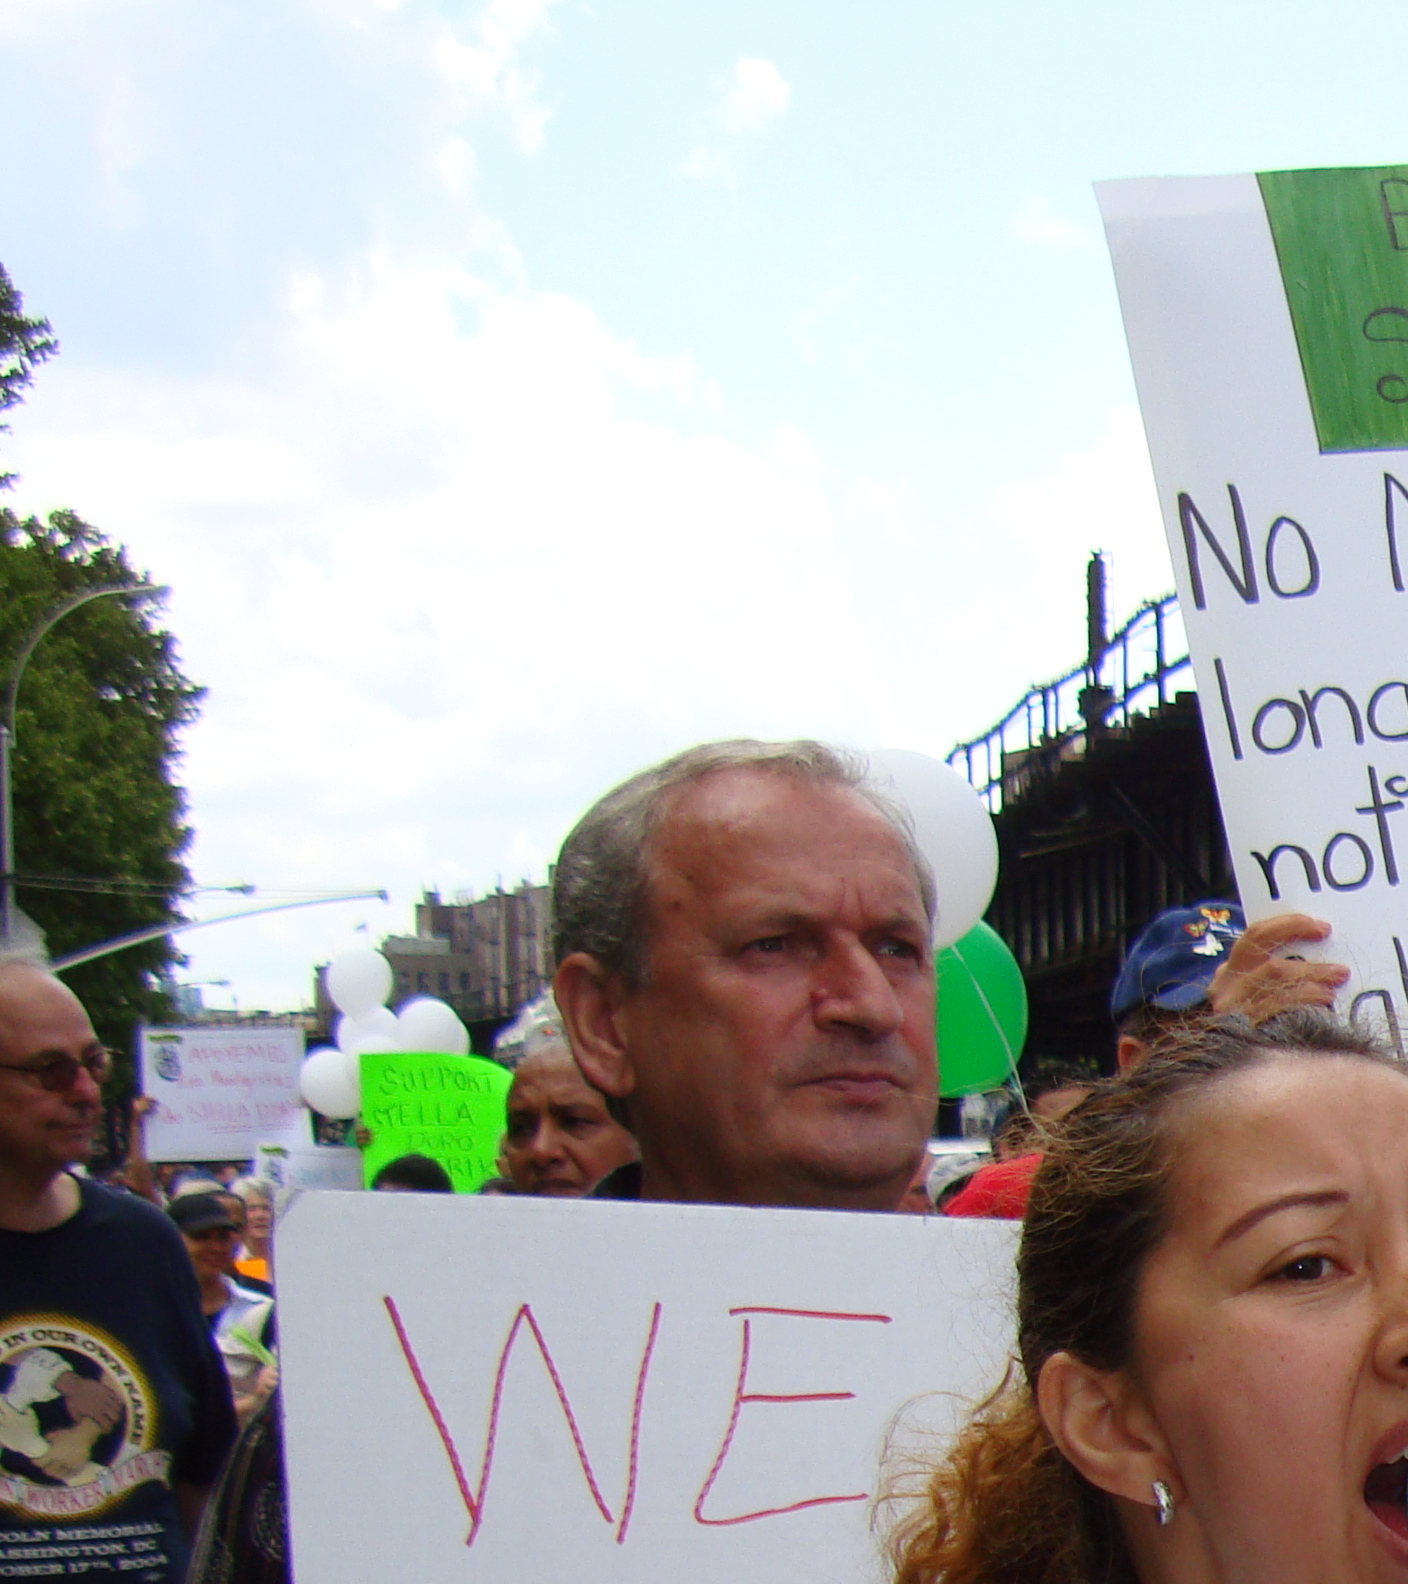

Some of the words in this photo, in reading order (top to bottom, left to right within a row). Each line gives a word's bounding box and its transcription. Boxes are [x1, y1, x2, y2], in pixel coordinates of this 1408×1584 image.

[1176, 484, 1320, 611] No
[1250, 764, 1404, 902] not
[378, 1063, 494, 1096] SUPPORT
[32, 1328, 80, 1346] OUR
[383, 1294, 894, 1548] WE
[54, 1521, 166, 1542] MEMORIAL
